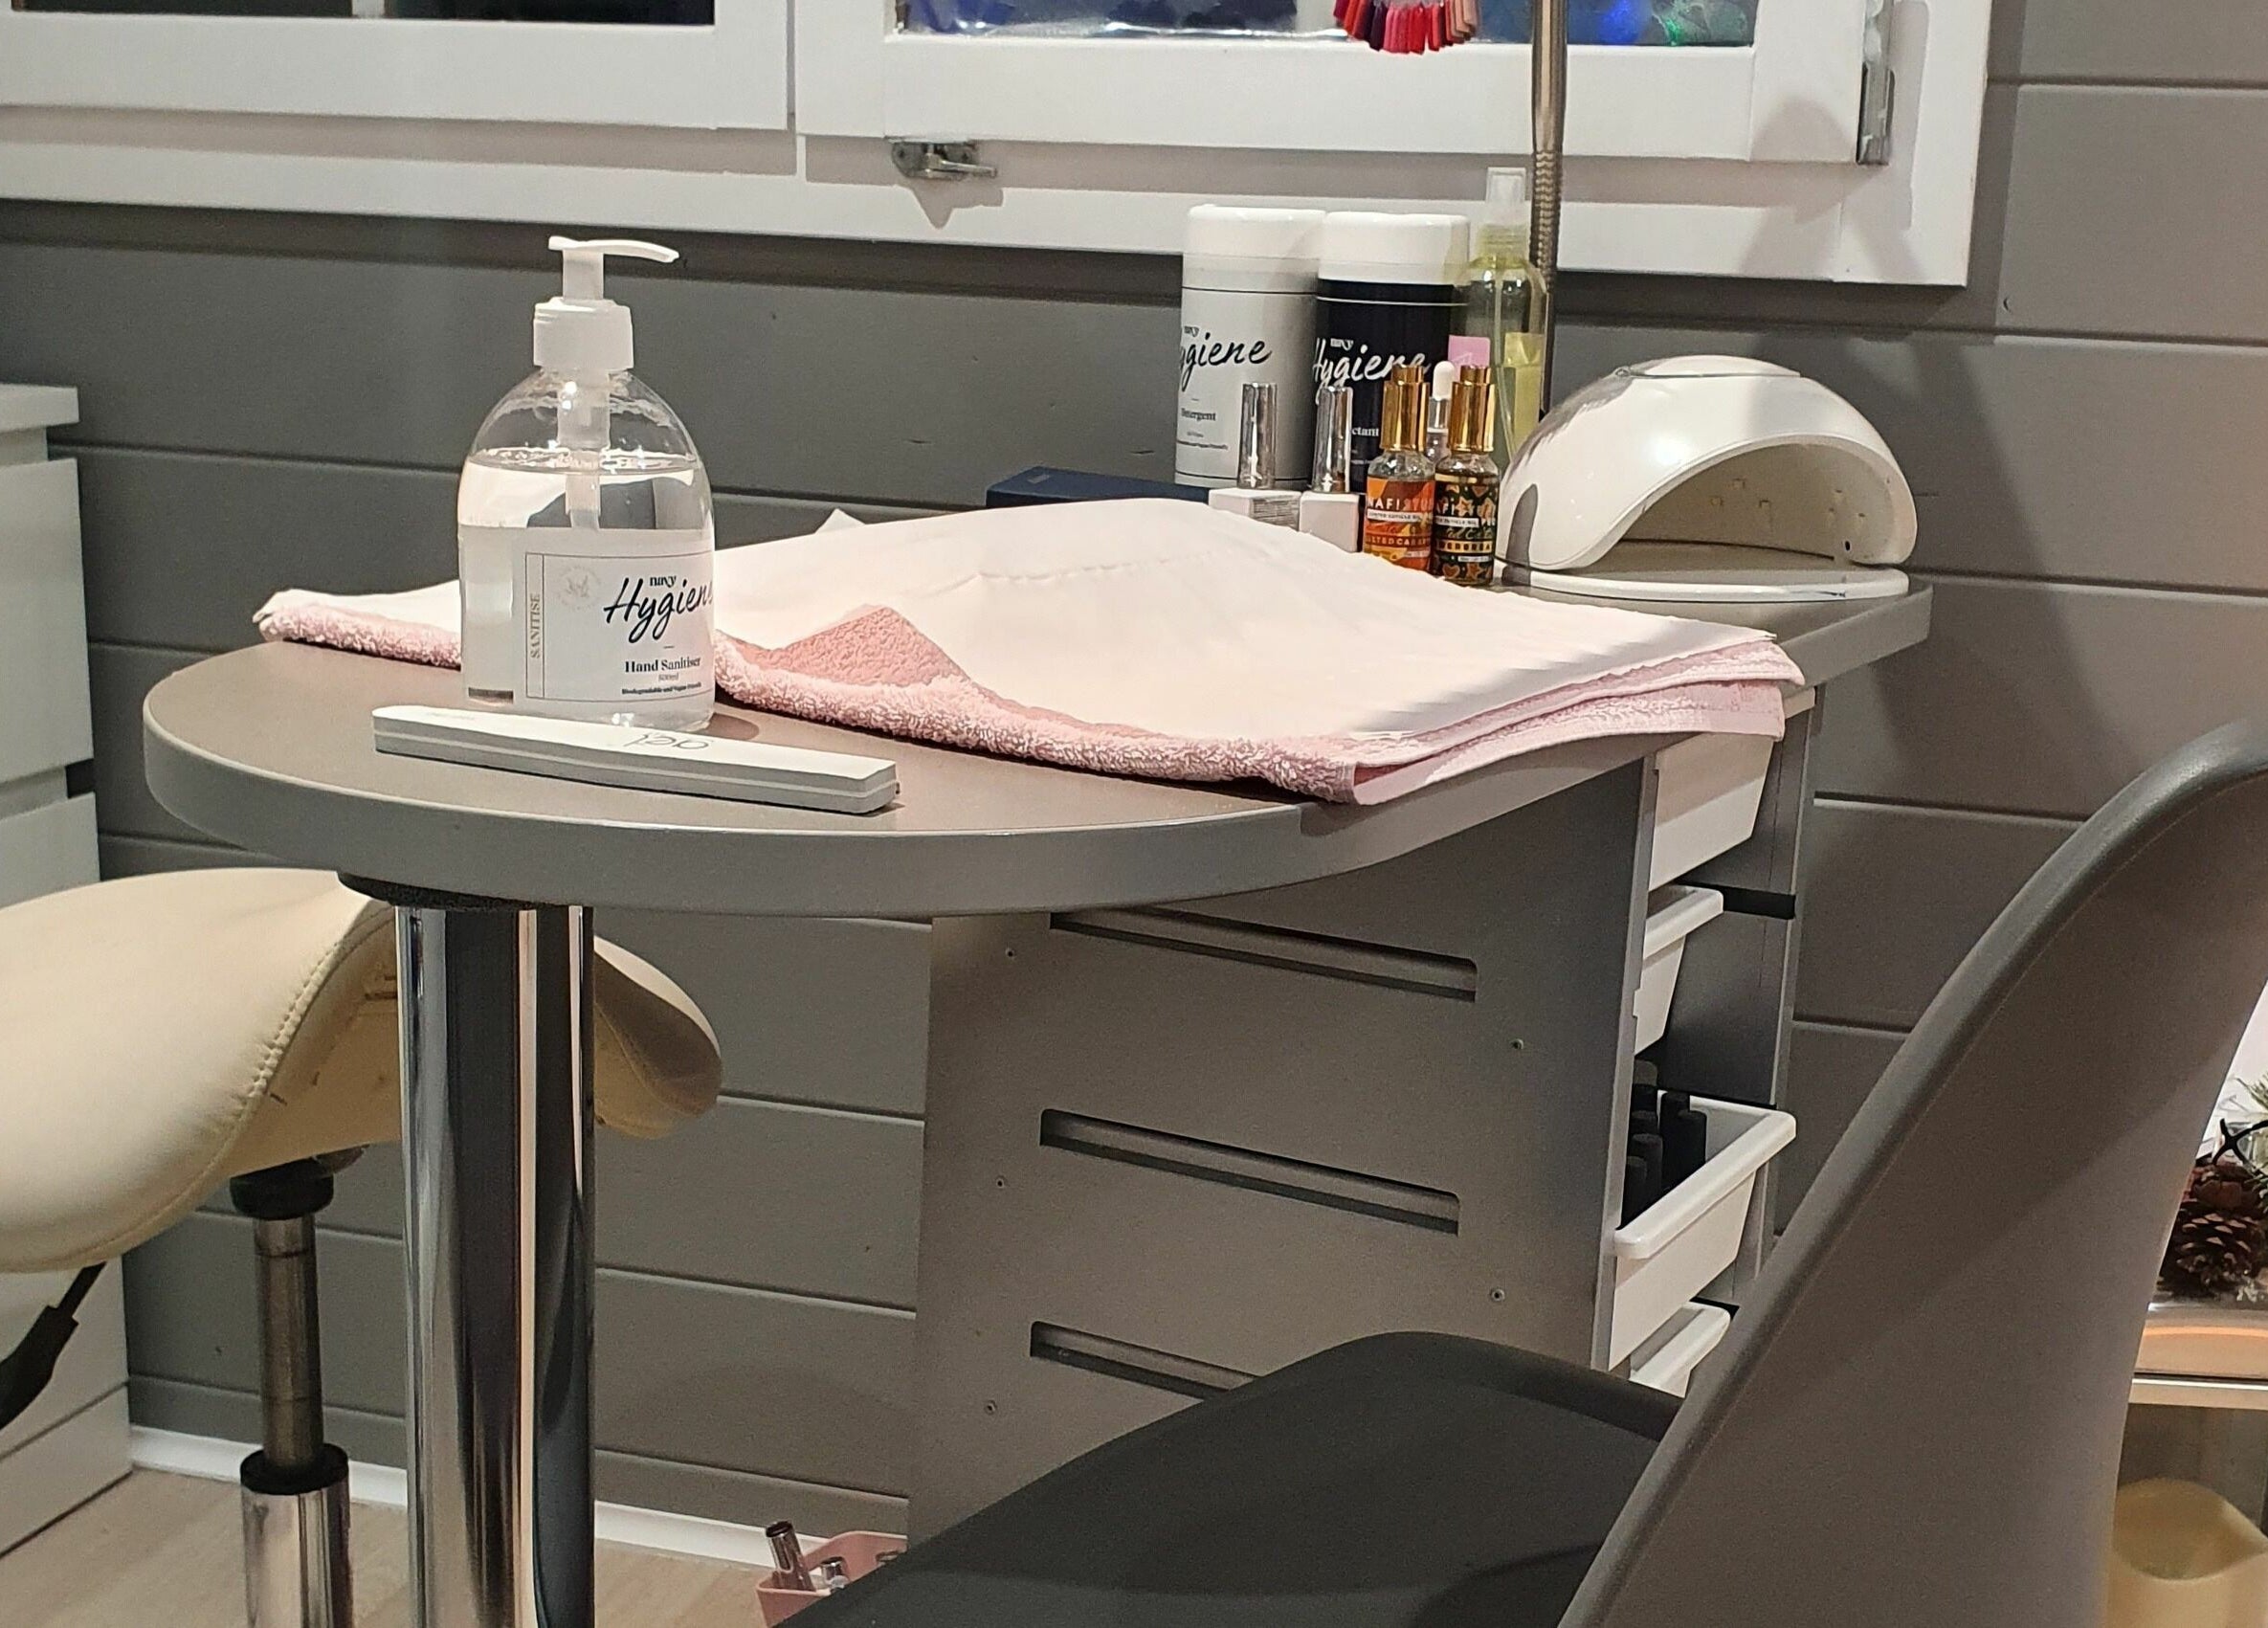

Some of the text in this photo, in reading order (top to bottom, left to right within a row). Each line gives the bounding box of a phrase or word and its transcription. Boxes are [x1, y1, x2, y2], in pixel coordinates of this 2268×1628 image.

[1180, 332, 1273, 392] giene
[530, 593, 541, 658] SANITISE
[625, 656, 700, 673] Hand Sanitiser
